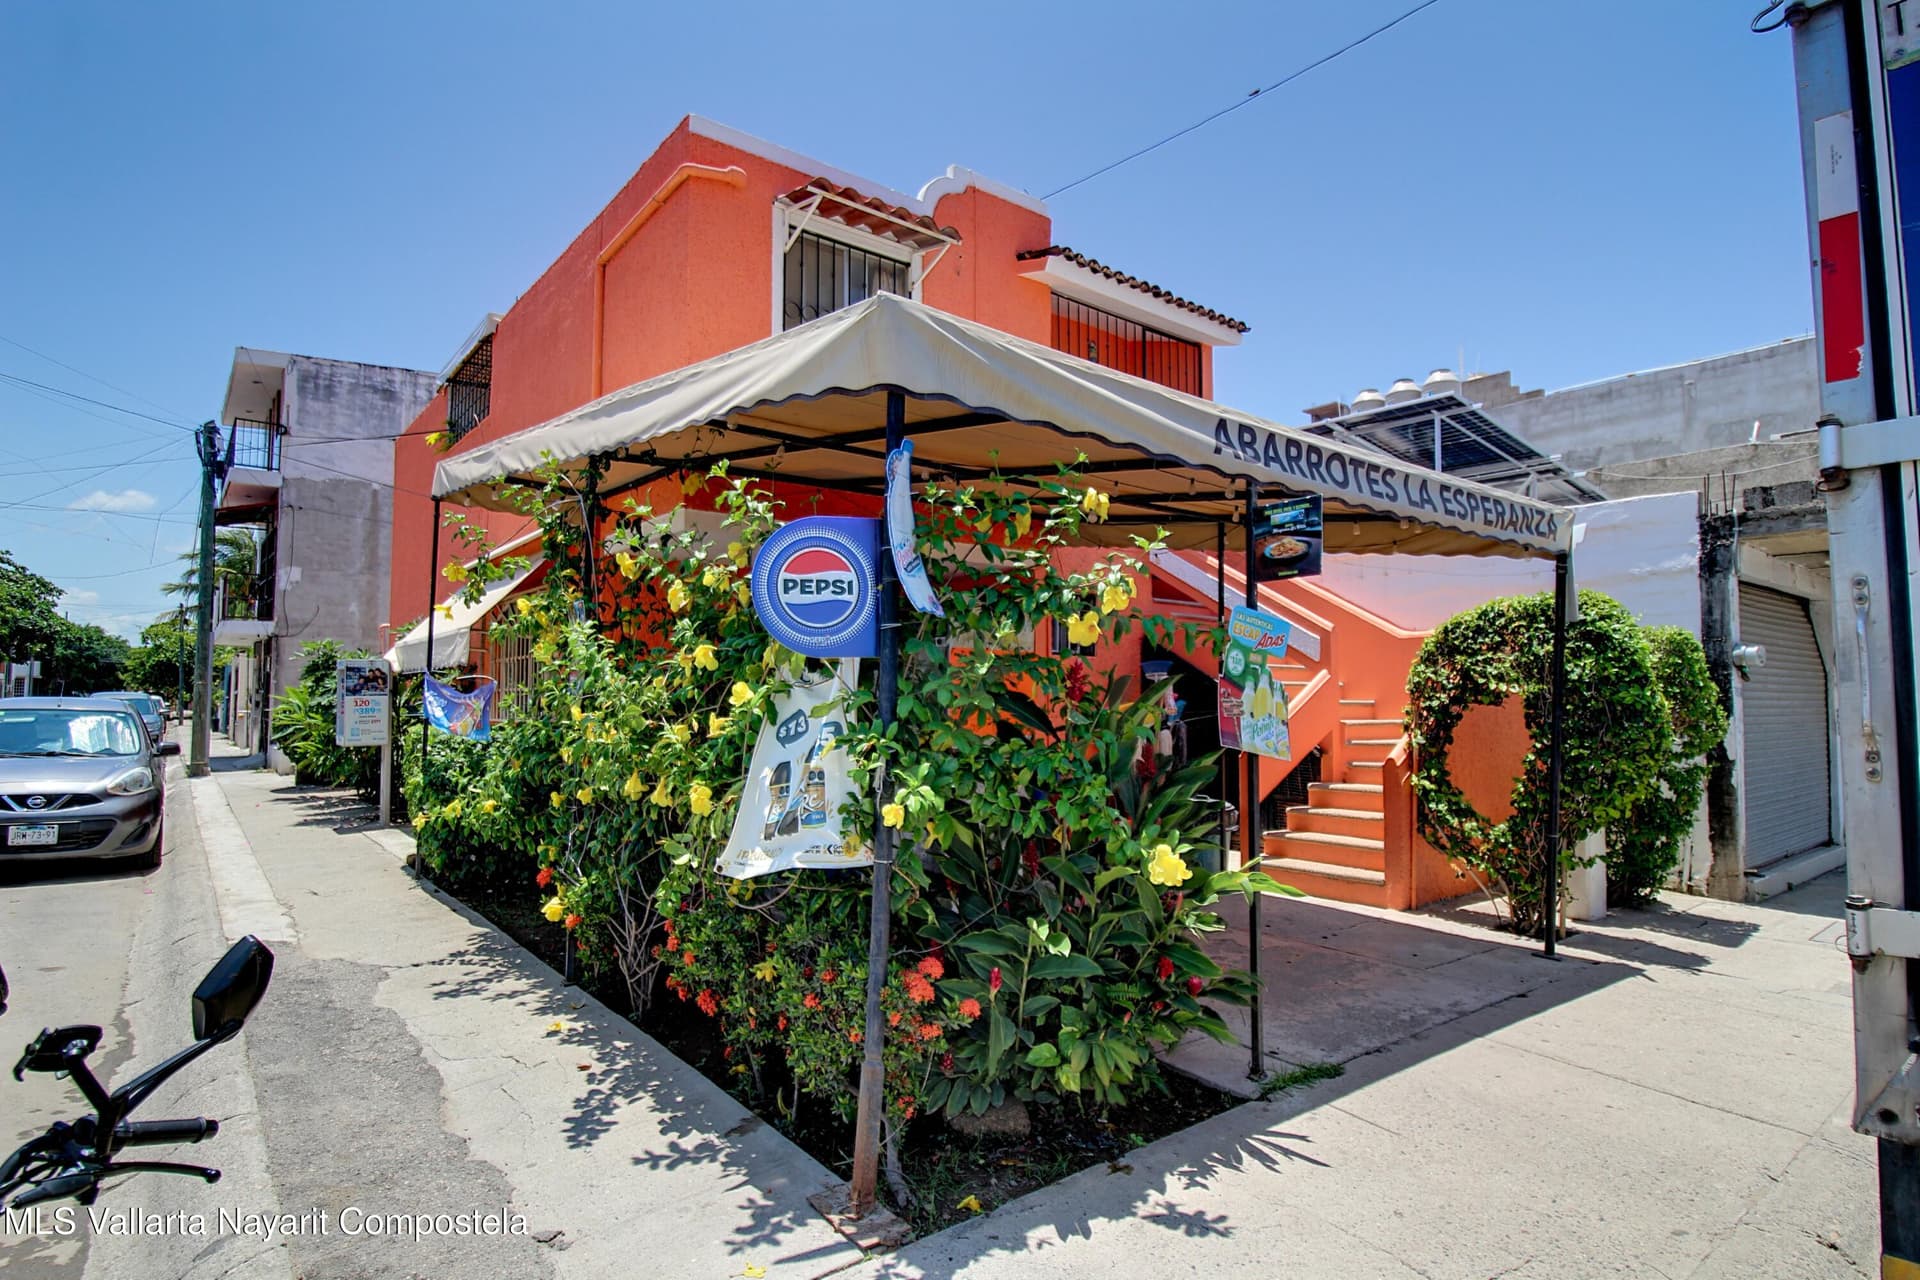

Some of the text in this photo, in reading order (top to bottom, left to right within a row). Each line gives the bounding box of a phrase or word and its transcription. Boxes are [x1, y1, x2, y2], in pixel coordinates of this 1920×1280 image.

[1213, 418, 1558, 541] ABARROTES LA ESPERANZA
[783, 579, 854, 596] PEPSI
[779, 715, 806, 738] $73
